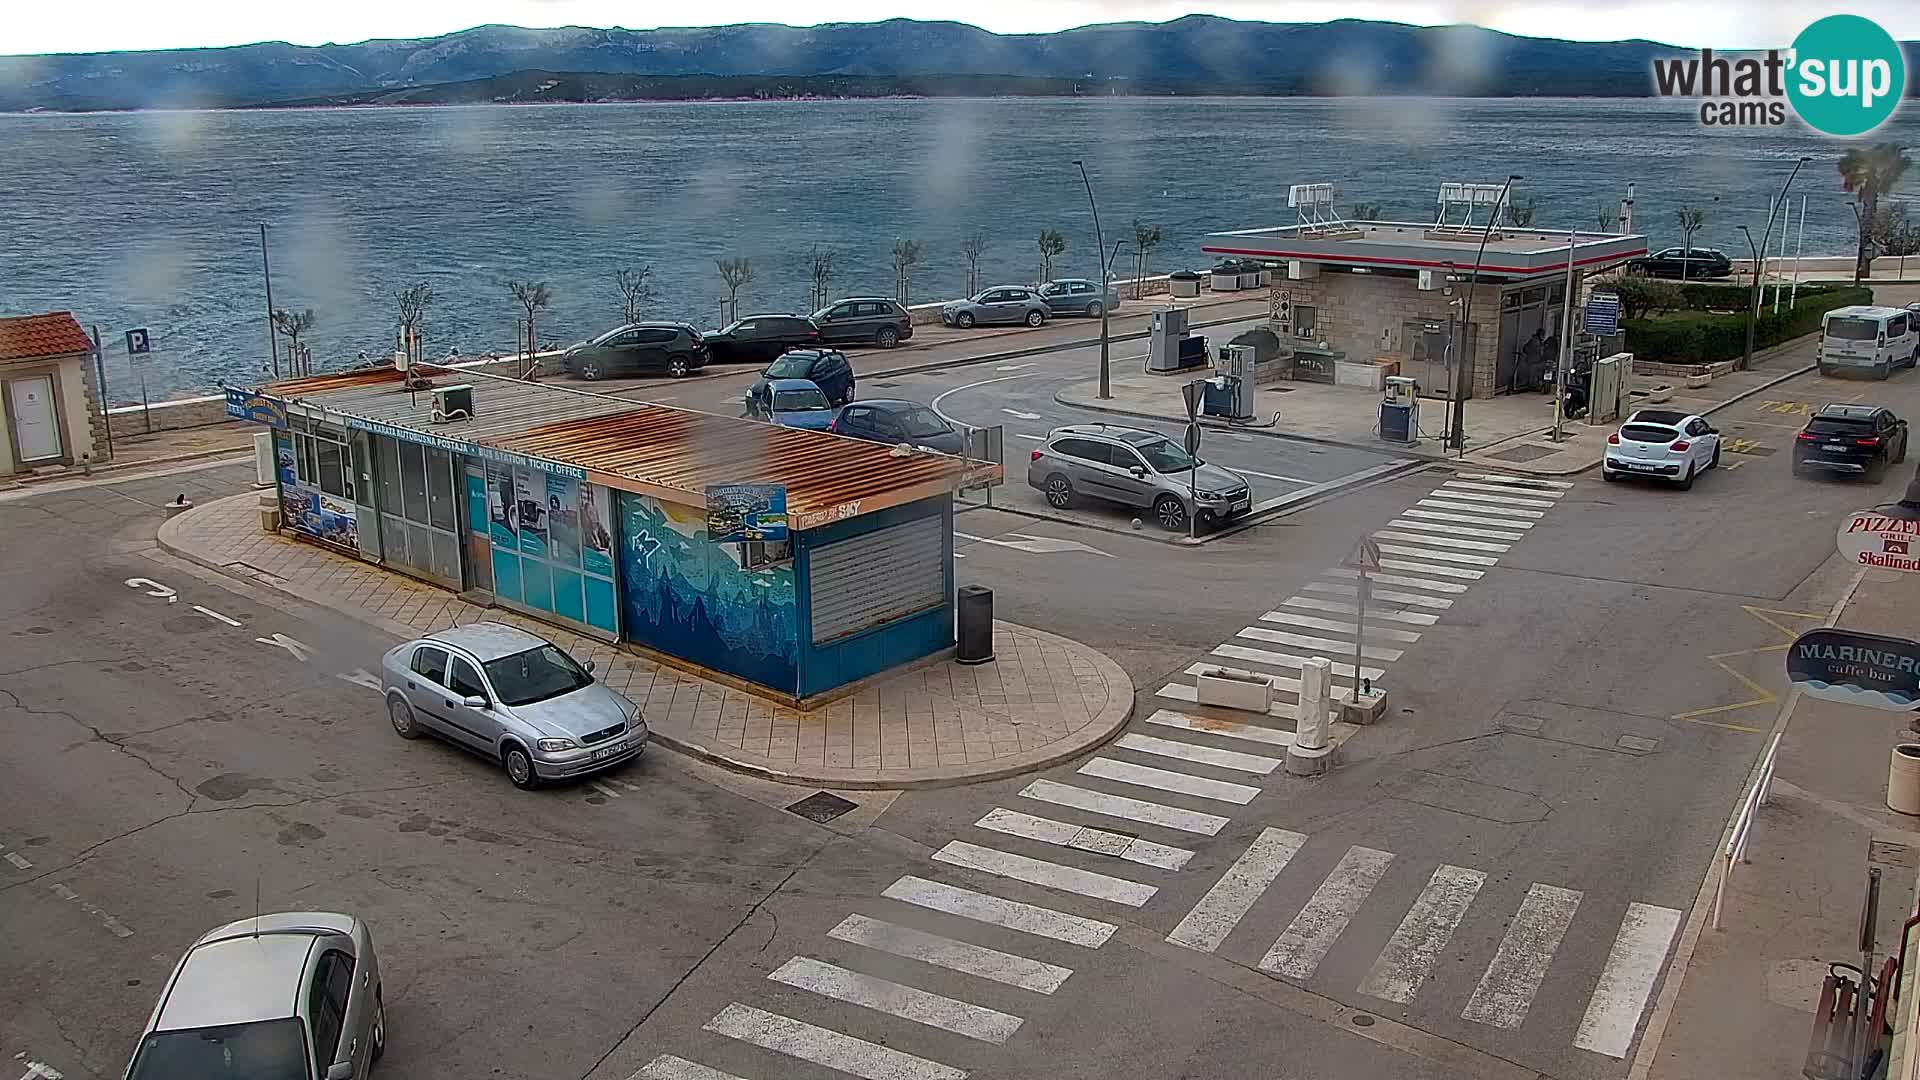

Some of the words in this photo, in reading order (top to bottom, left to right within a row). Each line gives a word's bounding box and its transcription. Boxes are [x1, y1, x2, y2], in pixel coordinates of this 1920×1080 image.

[131, 333, 144, 351] P
[436, 438, 468, 453] POSTAJA
[479, 447, 494, 459] BUS
[494, 450, 526, 466] STATION
[529, 458, 555, 472] TICKET
[555, 465, 583, 479] OFFICE
[1880, 532, 1915, 542] GRILL
[1827, 663, 1864, 677] caffe
[1869, 667, 1896, 682] bar
